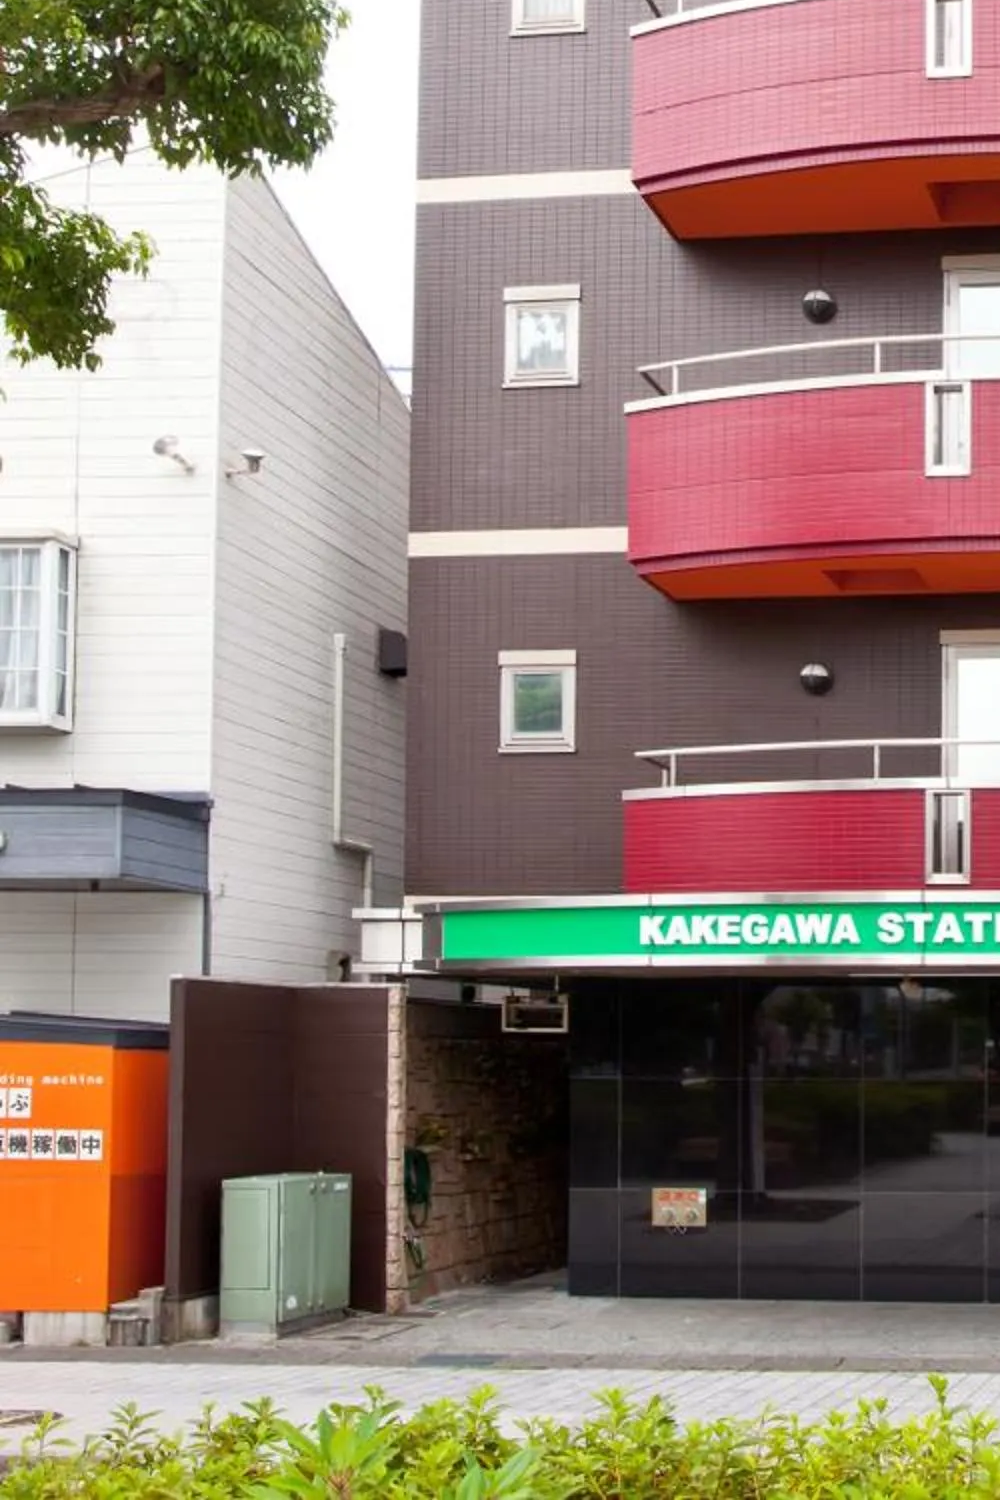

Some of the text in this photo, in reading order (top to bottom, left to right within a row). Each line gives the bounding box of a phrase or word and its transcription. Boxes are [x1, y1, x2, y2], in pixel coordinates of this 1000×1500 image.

[639, 913, 861, 945] KAKEGAWA
[41, 1075, 104, 1086] machine
[0, 1093, 29, 1112] ぶ
[0, 1134, 101, 1155] 機稼働中
